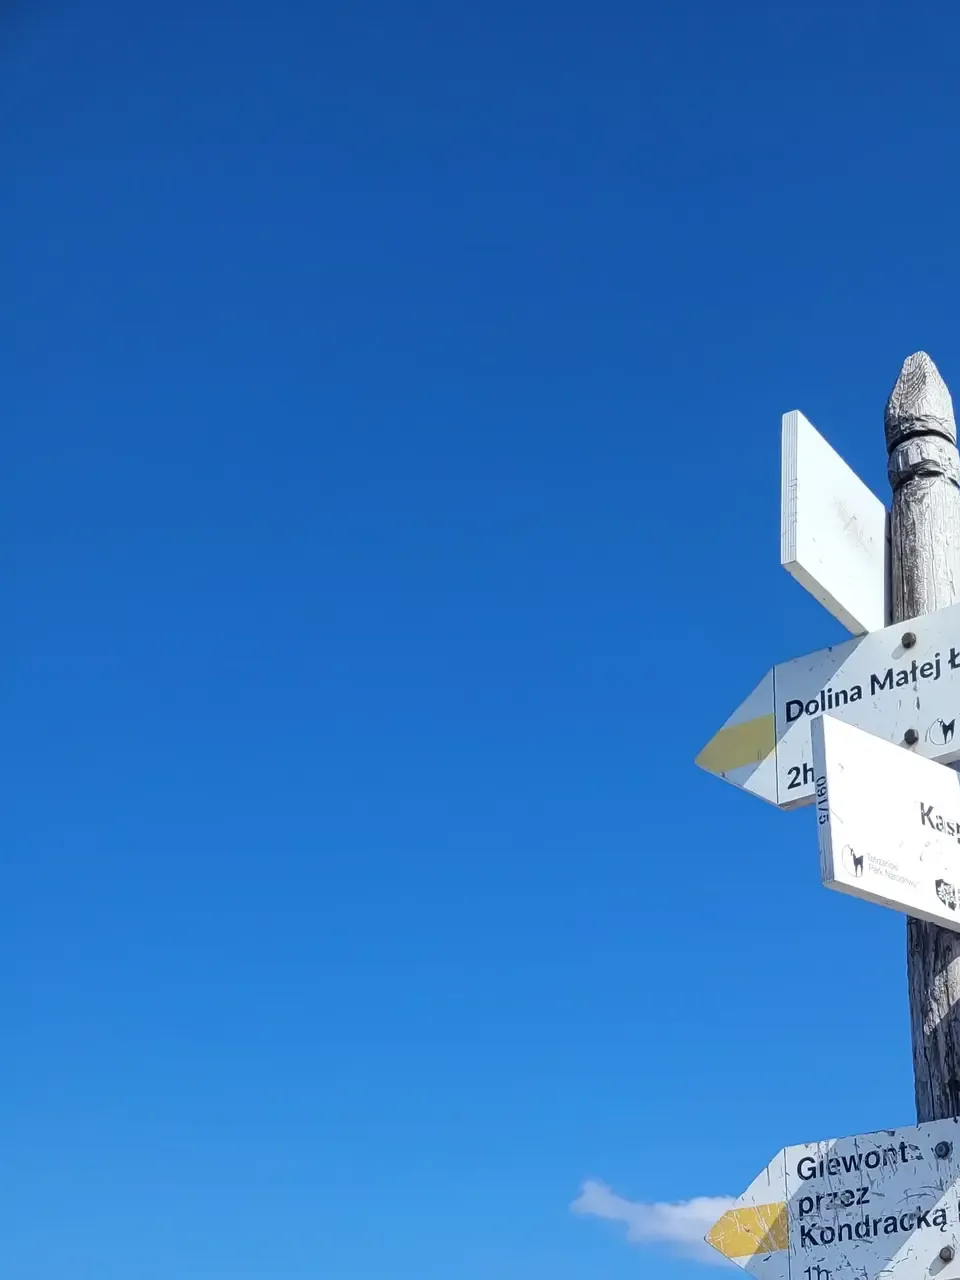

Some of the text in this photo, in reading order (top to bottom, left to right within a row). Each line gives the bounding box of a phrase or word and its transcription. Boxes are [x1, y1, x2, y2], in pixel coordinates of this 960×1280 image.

[786, 685, 862, 723] Dolina
[870, 652, 940, 695] Małej
[787, 763, 814, 790] 2h
[797, 1141, 909, 1181] Giewont
[799, 1186, 870, 1221] przez
[800, 1205, 947, 1248] Kondracką
